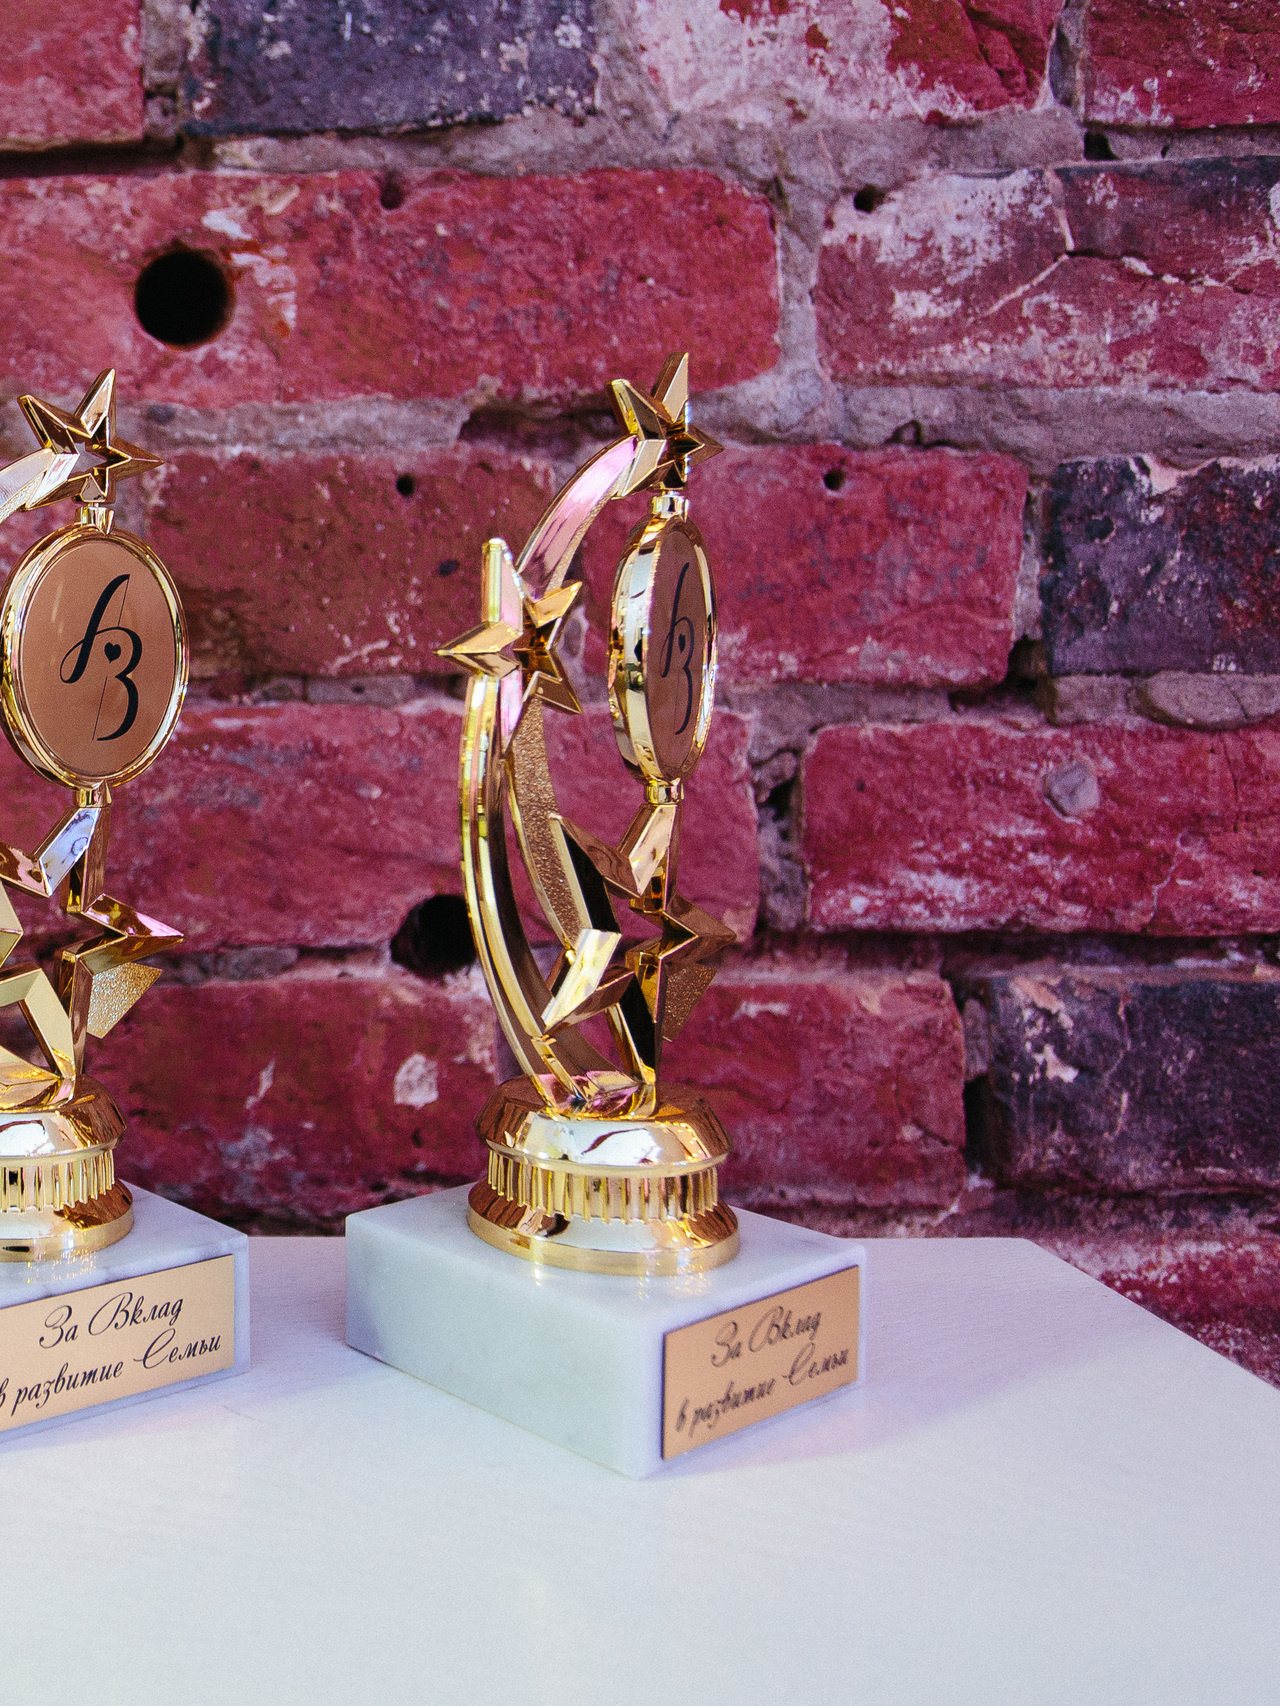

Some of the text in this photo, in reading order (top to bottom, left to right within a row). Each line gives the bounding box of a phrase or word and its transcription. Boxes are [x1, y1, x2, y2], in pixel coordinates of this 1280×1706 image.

[39, 1291, 184, 1349] За Вклад
[711, 1320, 742, 1367] За
[10, 1362, 124, 1417] развитие
[133, 1328, 221, 1370] Семьи
